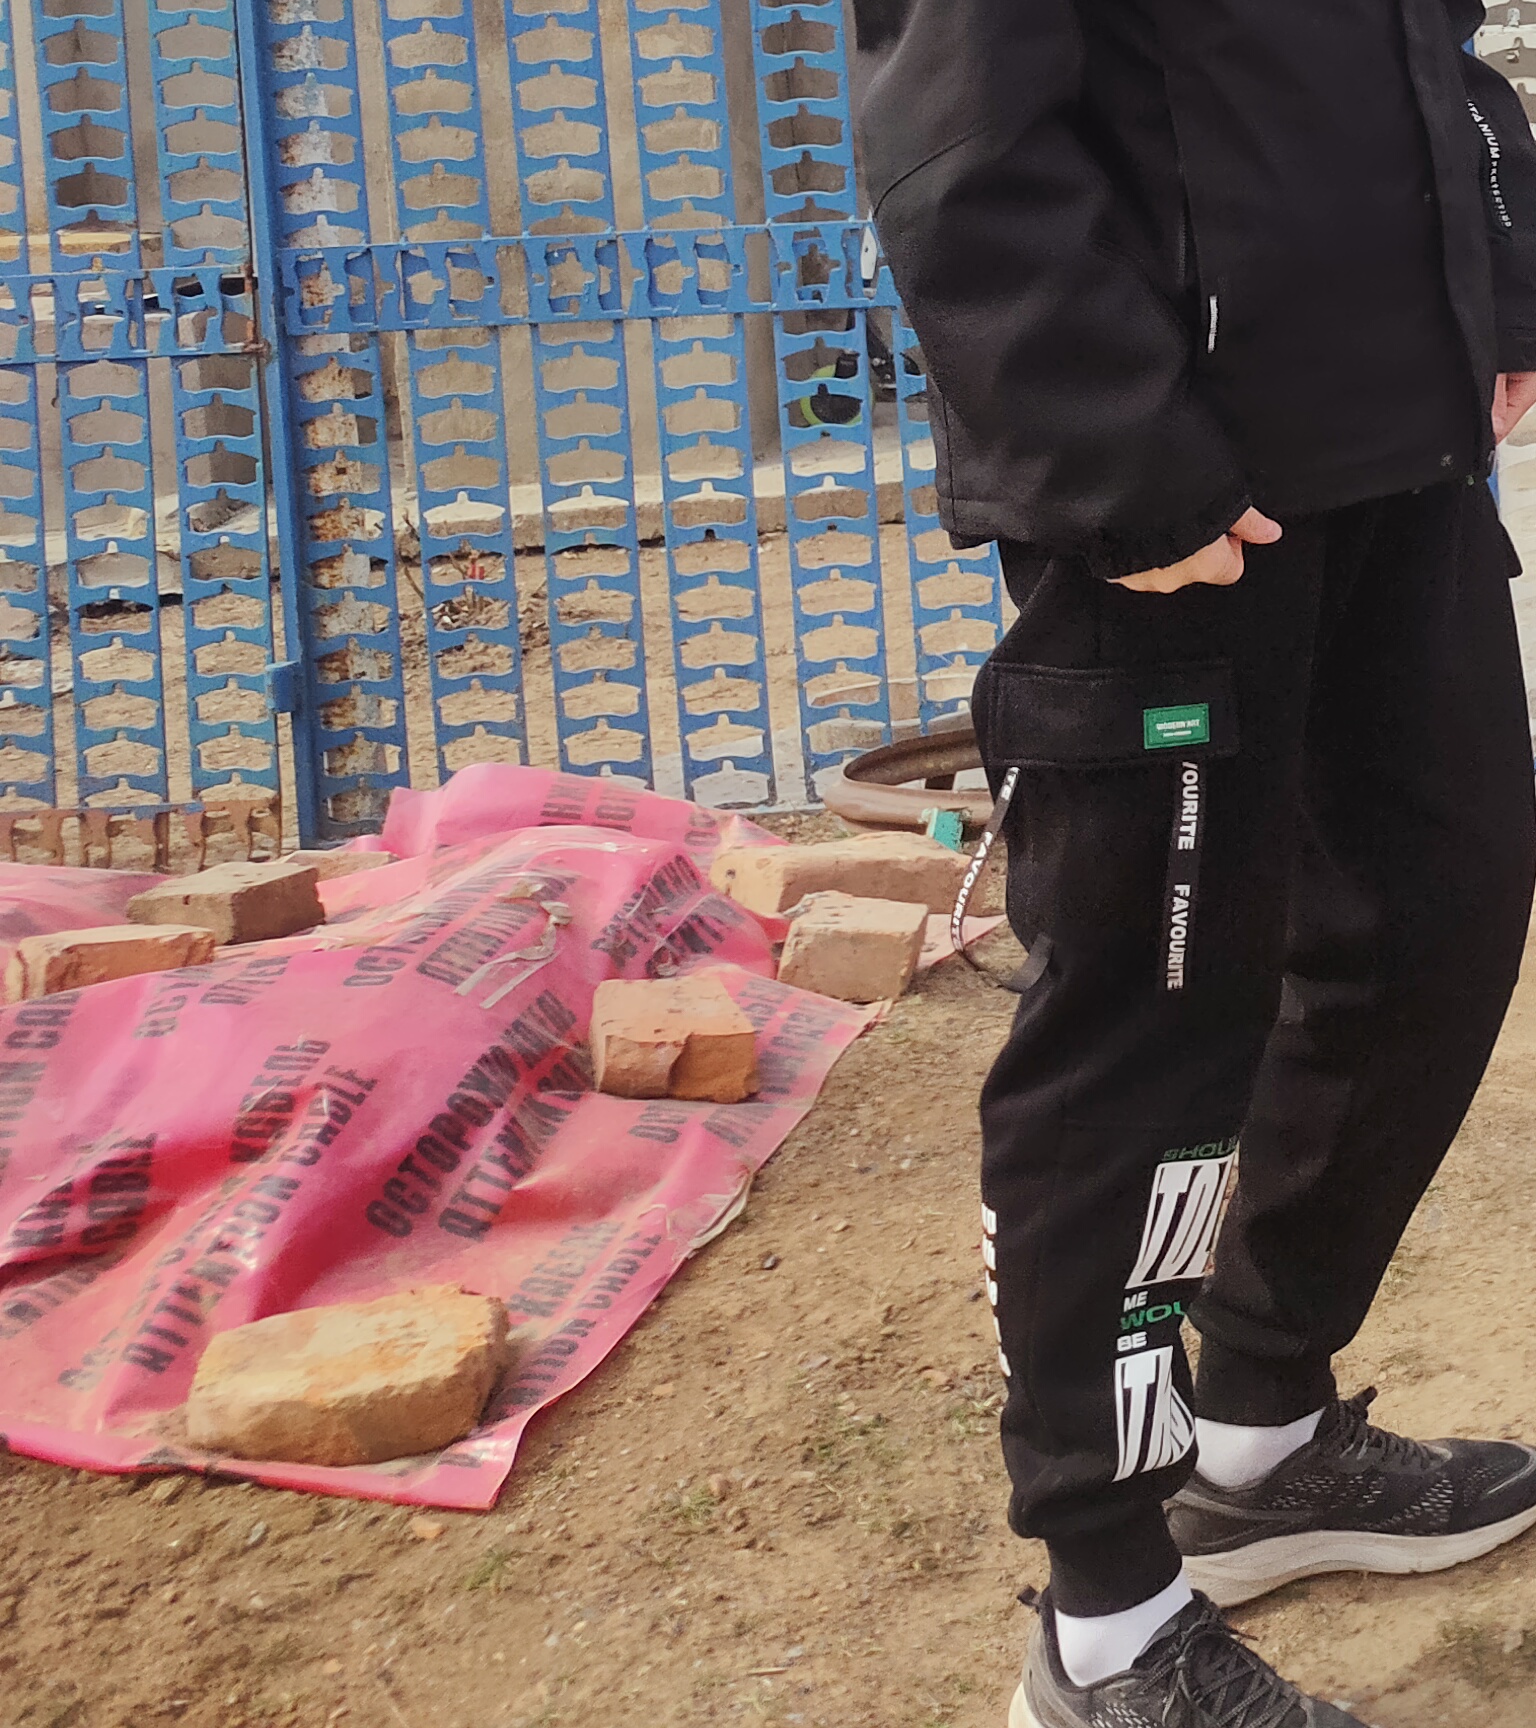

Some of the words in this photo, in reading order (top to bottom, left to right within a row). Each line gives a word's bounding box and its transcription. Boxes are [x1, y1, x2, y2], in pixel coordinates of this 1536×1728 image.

[1166, 884, 1191, 991] FAVOURITE
[279, 1064, 378, 1166] CABLE
[1123, 1291, 1149, 1313] ME
[1117, 1331, 1148, 1352] BE
